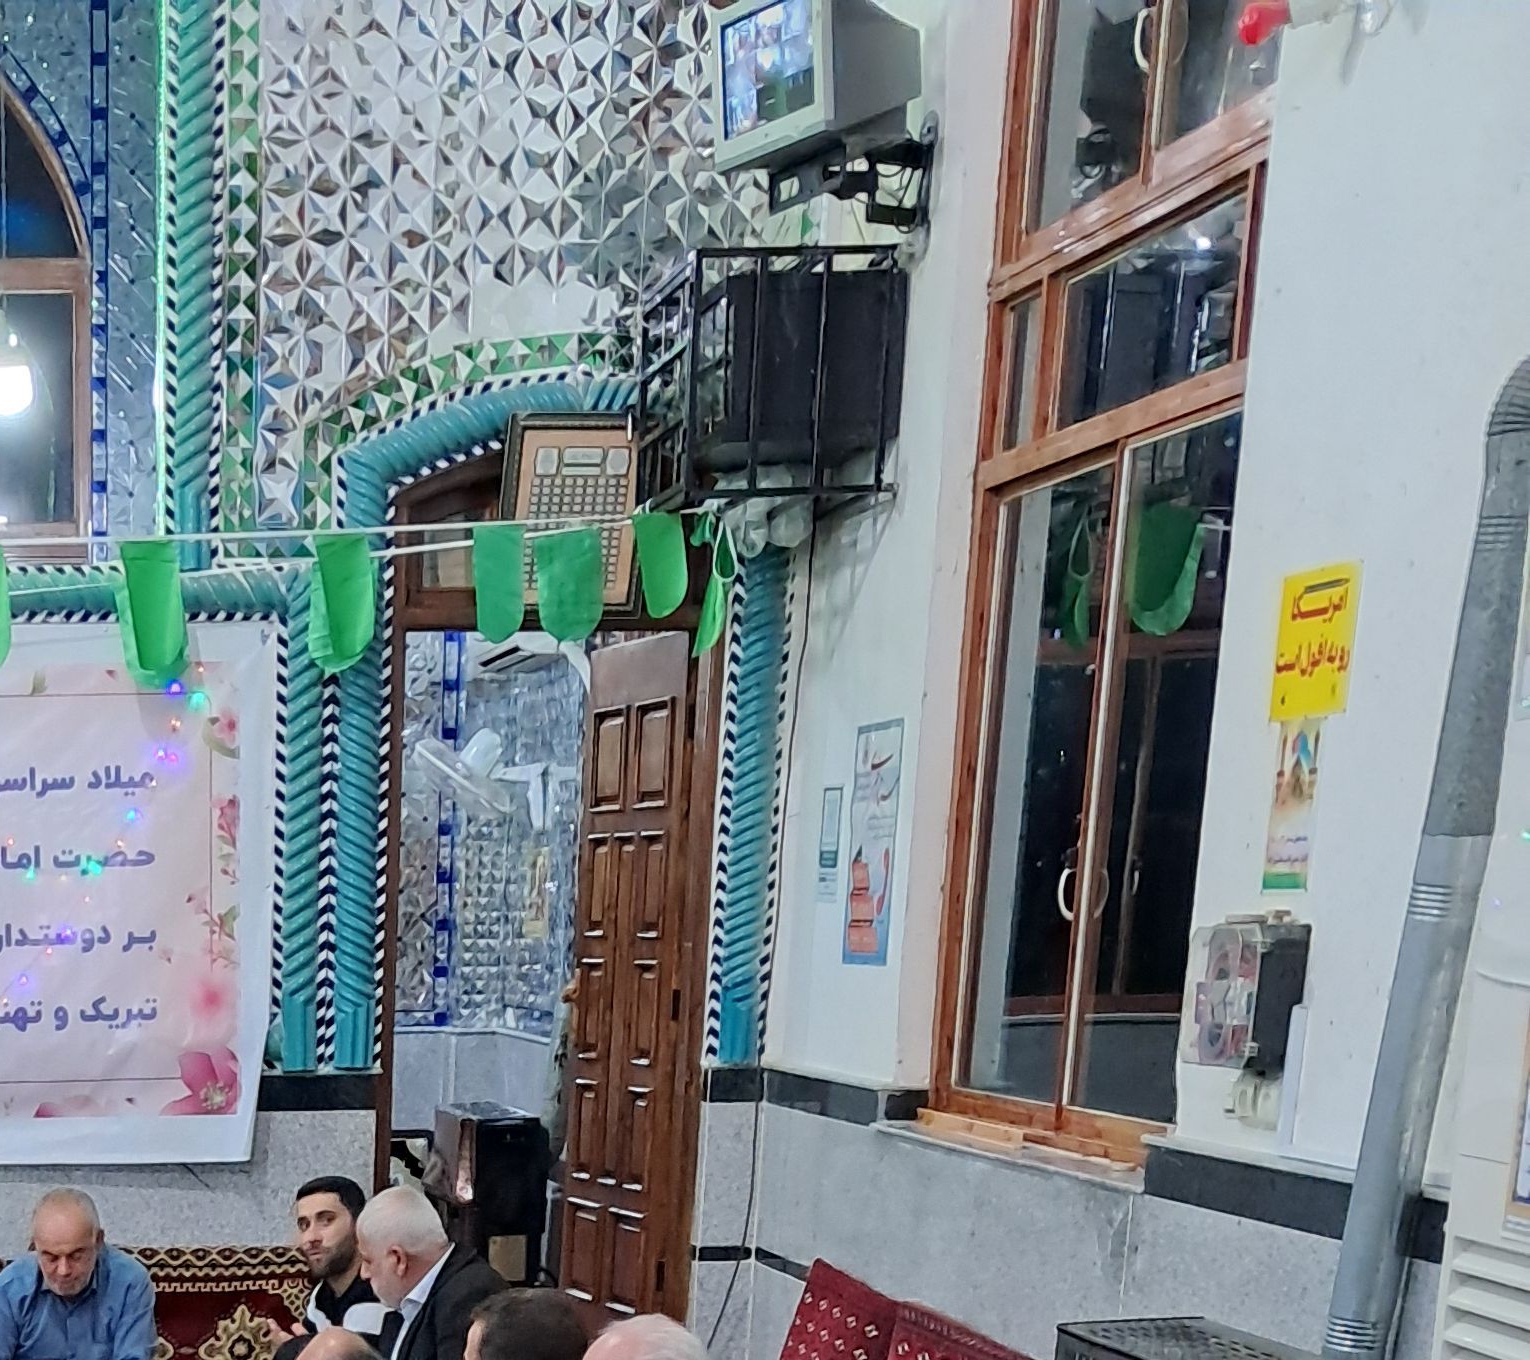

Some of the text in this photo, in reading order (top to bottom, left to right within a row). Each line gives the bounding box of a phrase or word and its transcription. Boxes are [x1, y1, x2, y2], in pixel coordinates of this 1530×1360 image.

[1275, 644, 1302, 674] است
[87, 765, 157, 797] میلاد
[53, 849, 155, 876] حضرت
[122, 929, 157, 952] بر
[53, 1005, 69, 1031] و
[80, 995, 158, 1029] تبریک
